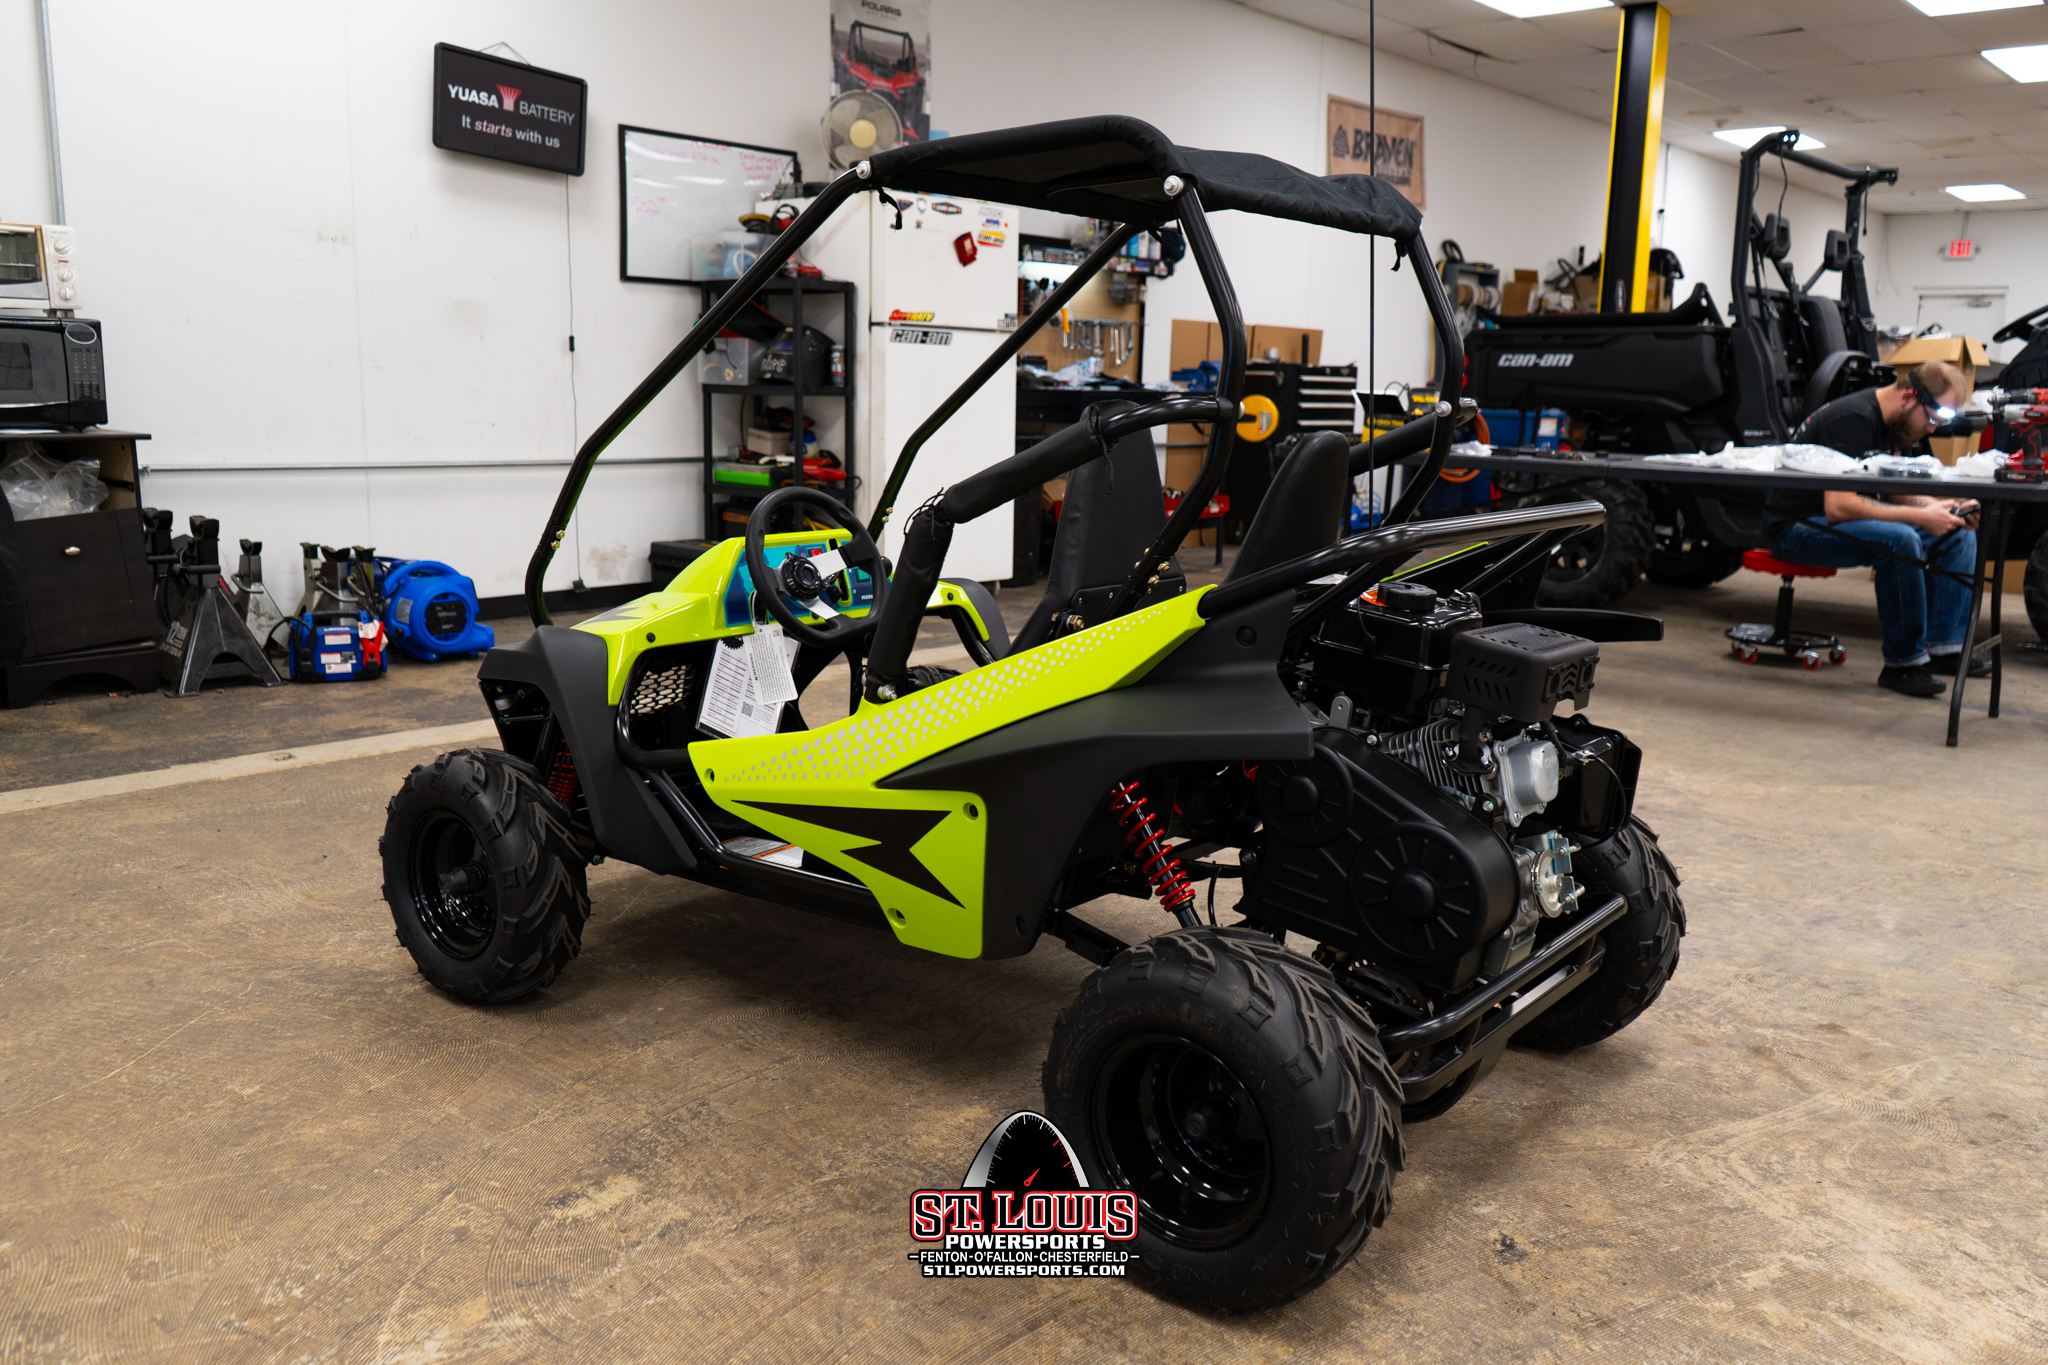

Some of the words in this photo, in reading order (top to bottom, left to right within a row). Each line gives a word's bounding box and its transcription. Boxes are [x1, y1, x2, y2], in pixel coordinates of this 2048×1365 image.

[861, 0, 902, 16] POLARIS
[447, 83, 499, 109] YUASA
[519, 101, 575, 126] BATTERY
[461, 114, 471, 129] It
[474, 119, 513, 138] starts
[515, 128, 542, 144] with
[545, 136, 560, 148] us
[1950, 240, 1972, 257] EXIT
[891, 329, 952, 345] can-am
[1497, 353, 1574, 367] can-am
